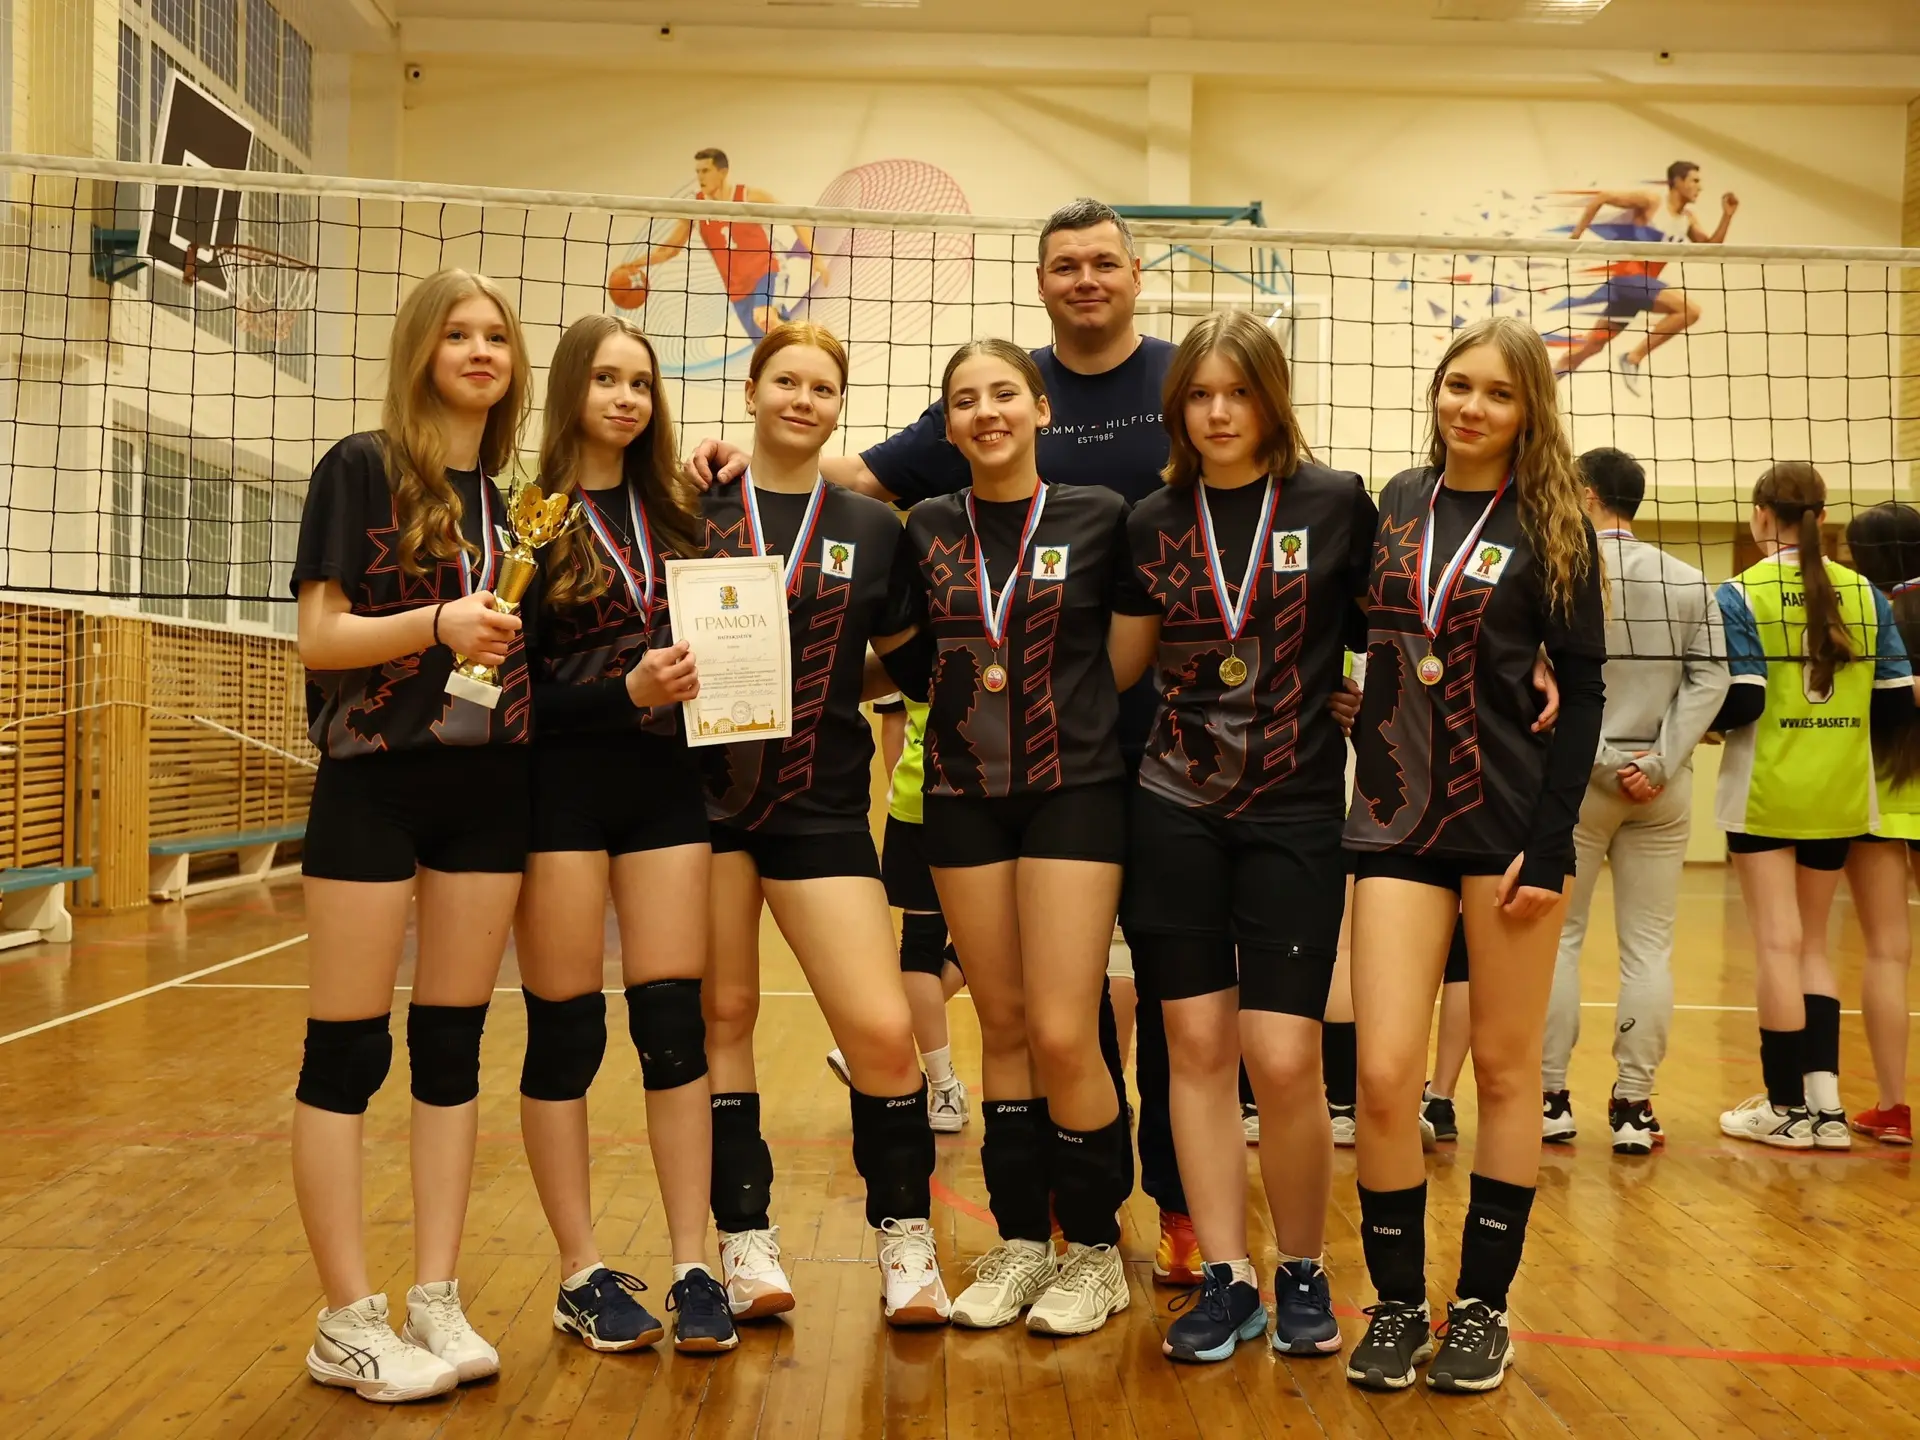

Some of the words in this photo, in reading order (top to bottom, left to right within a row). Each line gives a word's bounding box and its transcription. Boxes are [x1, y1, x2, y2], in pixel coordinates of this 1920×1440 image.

[1040, 424, 1085, 435] OMMY
[1106, 413, 1164, 429] HILFIGE
[694, 614, 767, 631] ГРАМОТА
[910, 1224, 924, 1232] NIKE
[1372, 1225, 1402, 1236] BJÖRD
[1479, 1216, 1508, 1231] BJÖRD
